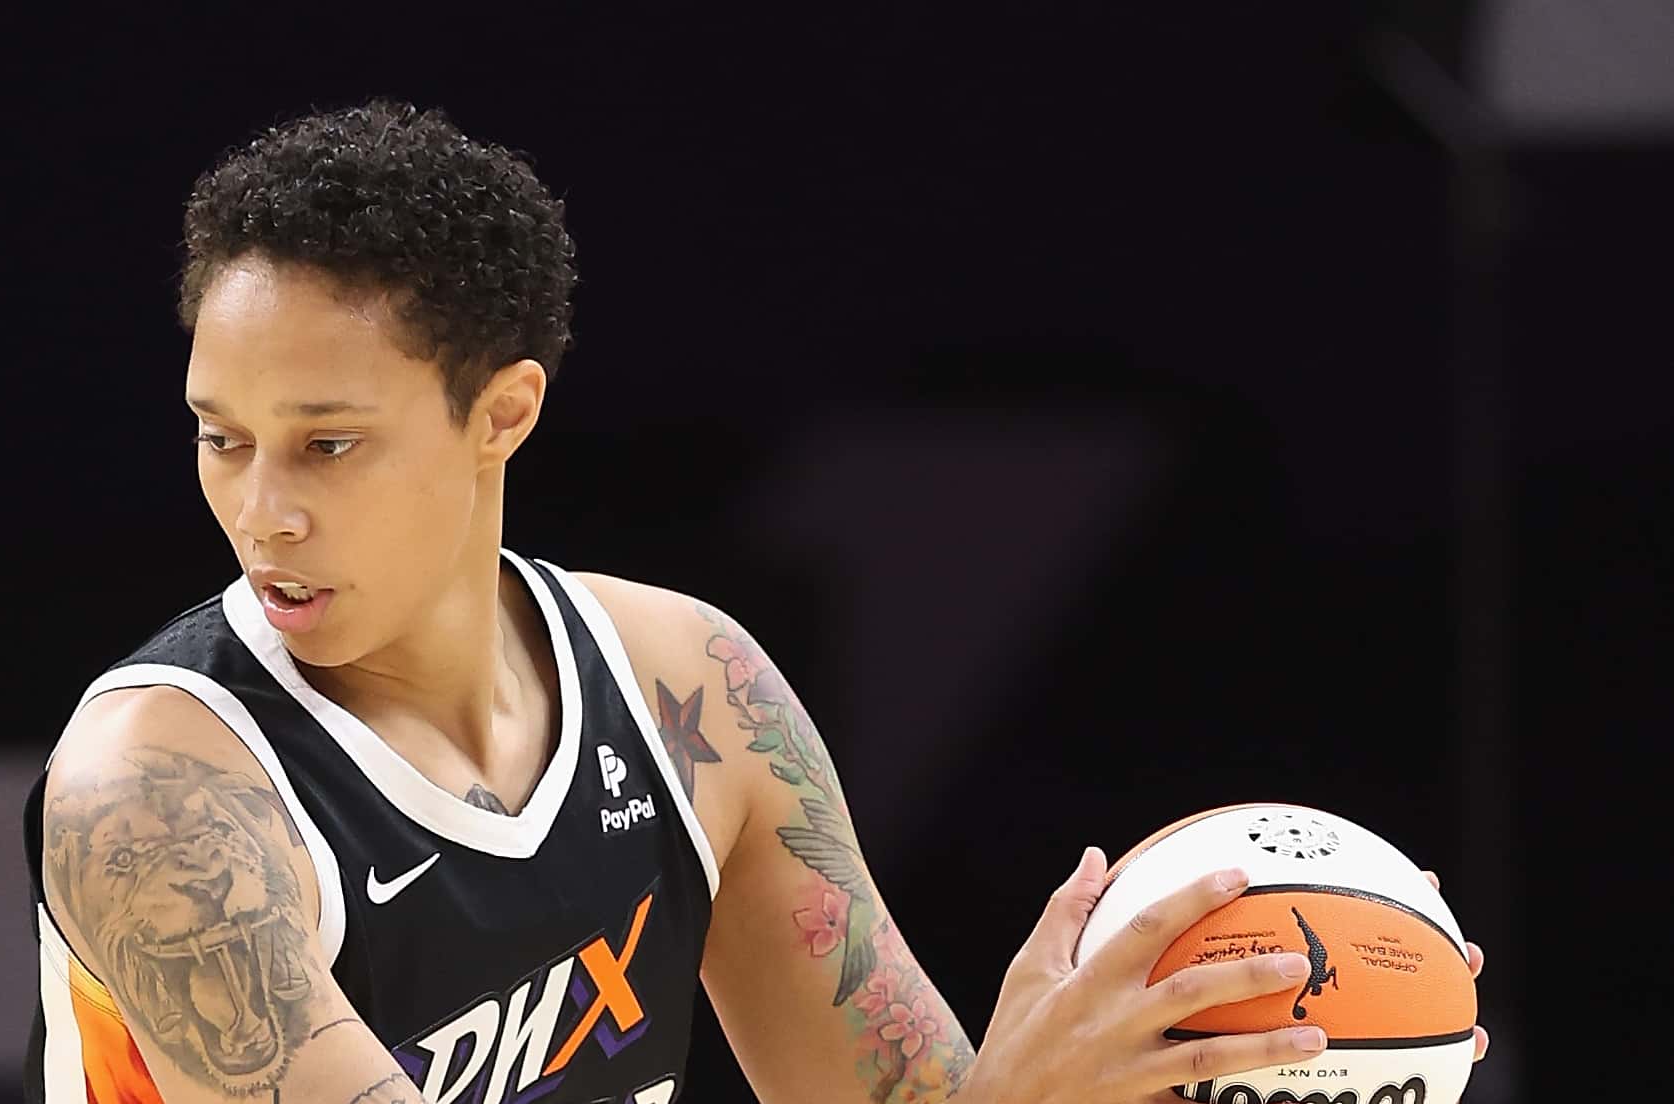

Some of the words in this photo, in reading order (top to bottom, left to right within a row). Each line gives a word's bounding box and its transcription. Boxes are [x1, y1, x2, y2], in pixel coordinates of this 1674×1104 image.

[600, 793, 656, 833] PayPal
[1349, 943, 1386, 957] BALL
[1388, 947, 1424, 962] GAME
[1360, 957, 1418, 974] OFFICIAL
[1277, 1067, 1310, 1078] NXT
[1315, 1068, 1348, 1078] EVO
